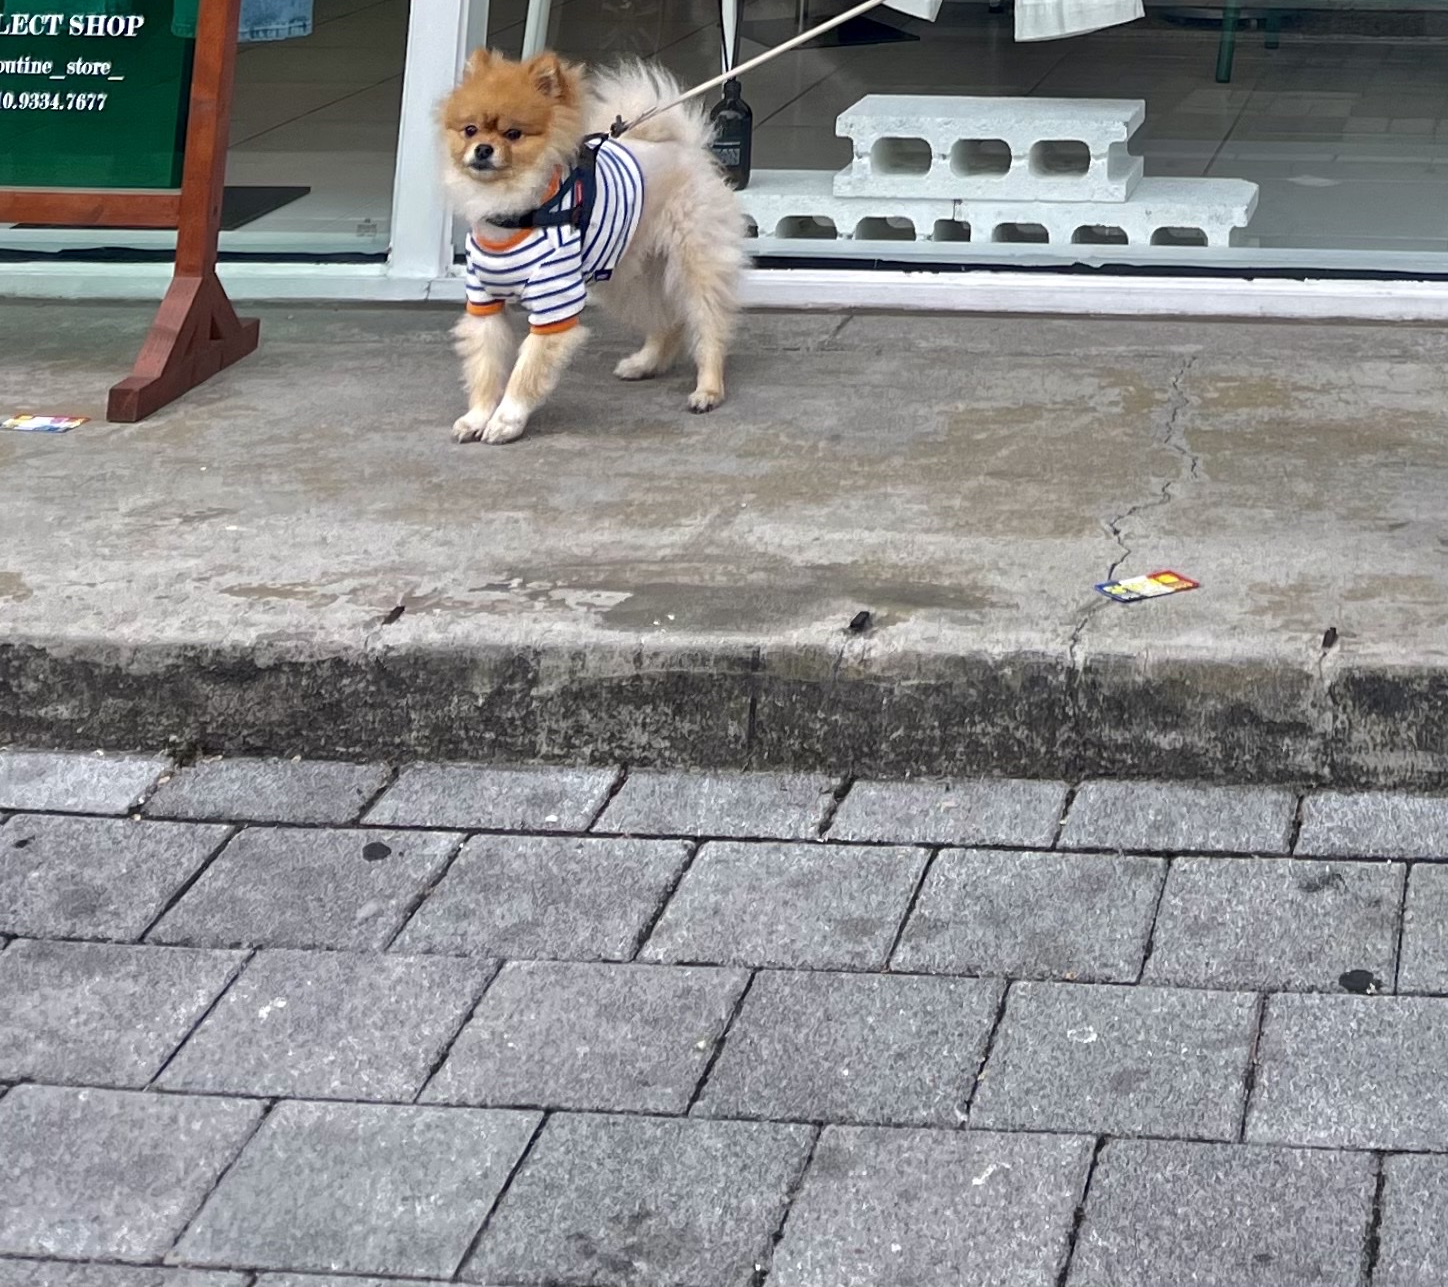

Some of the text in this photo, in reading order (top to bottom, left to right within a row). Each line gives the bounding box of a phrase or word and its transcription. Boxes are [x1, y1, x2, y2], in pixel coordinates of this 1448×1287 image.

[0, 13, 145, 37] LECT SHOP
[0, 55, 125, 81] outine_store_
[0, 91, 108, 111] 0.9334.7677
